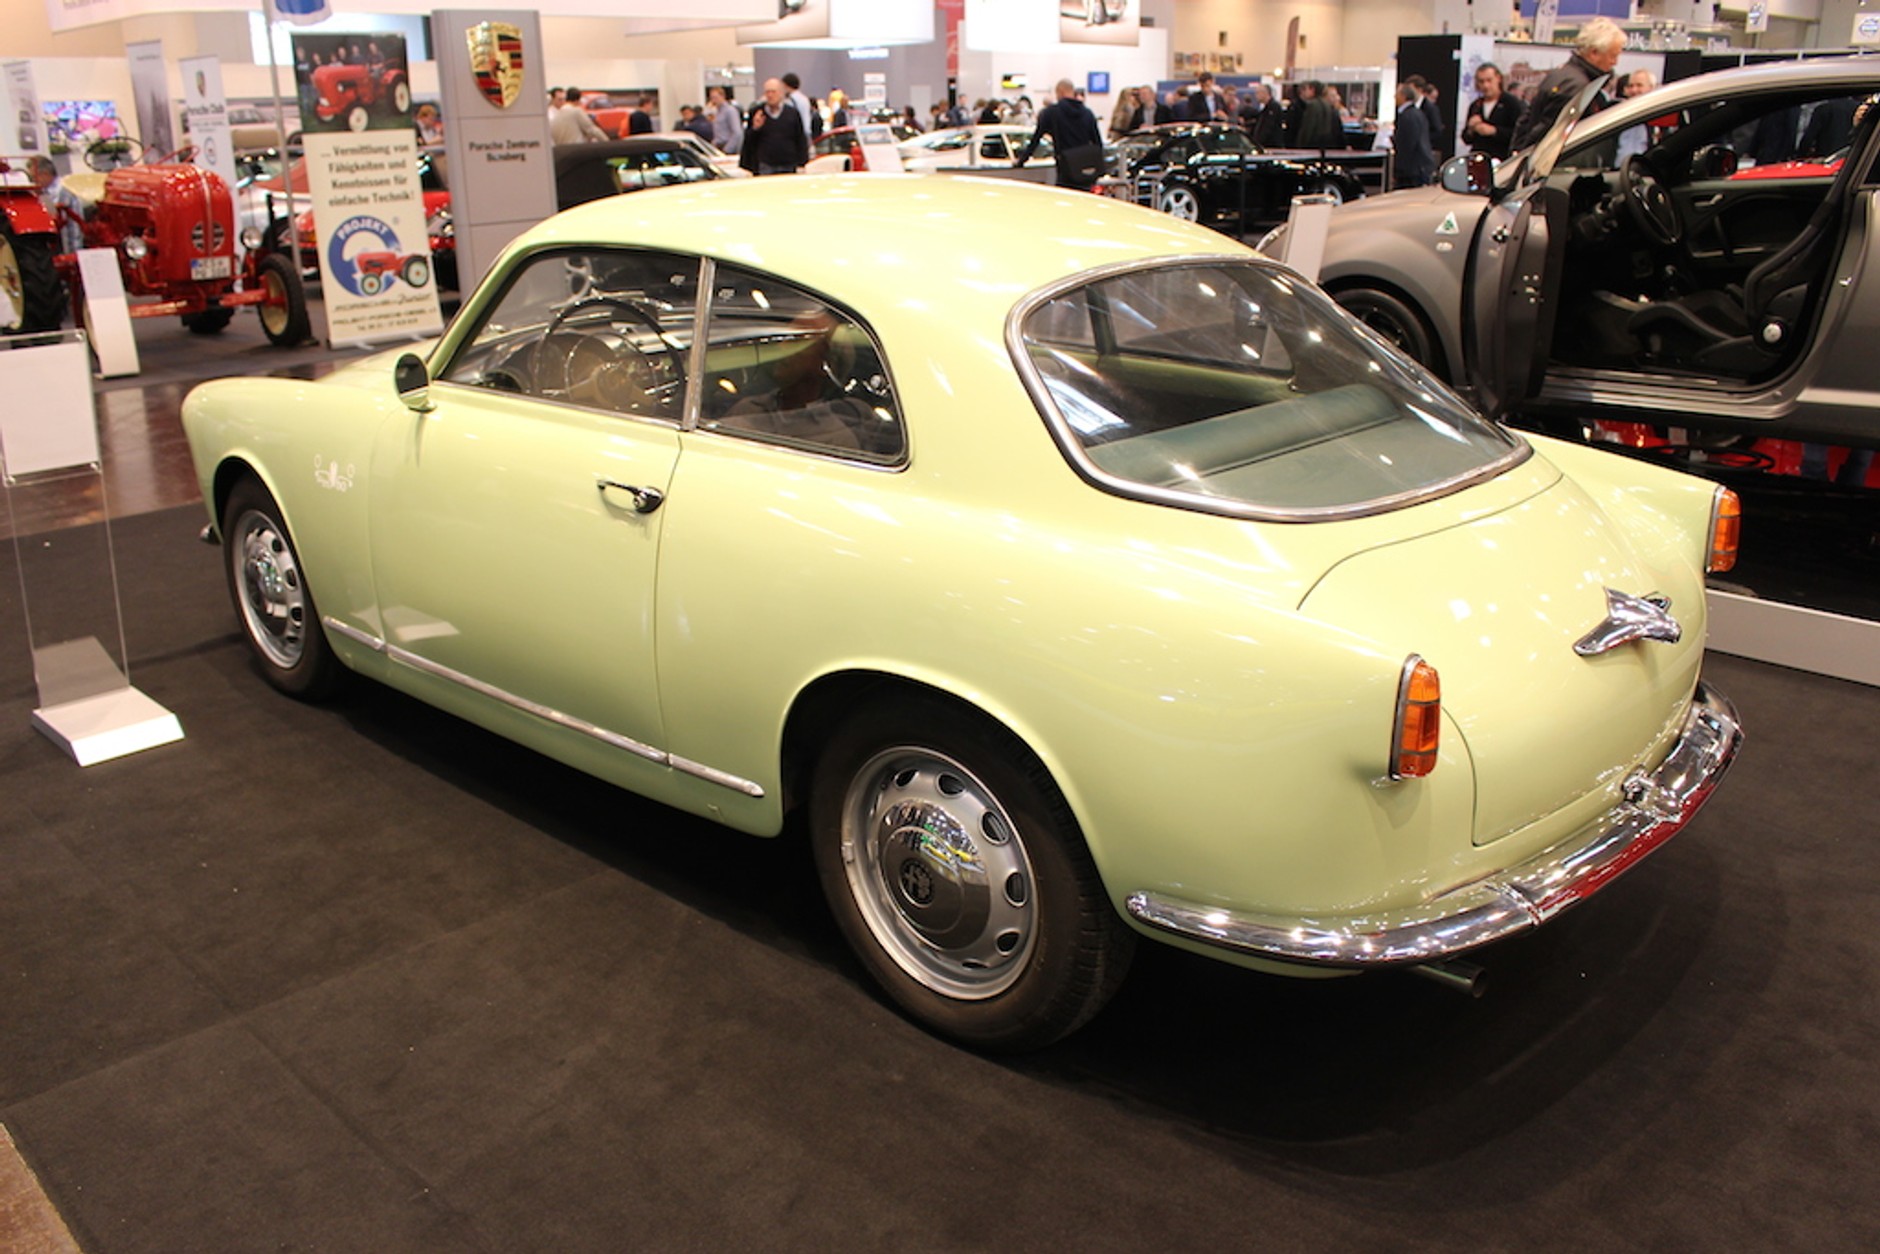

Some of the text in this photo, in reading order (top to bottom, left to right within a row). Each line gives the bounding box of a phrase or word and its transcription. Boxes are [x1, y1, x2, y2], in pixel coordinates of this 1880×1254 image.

[393, 144, 409, 153] von
[468, 140, 540, 151] Porsche Zentrum
[388, 159, 406, 169] und
[336, 218, 388, 240] PROJEKT
